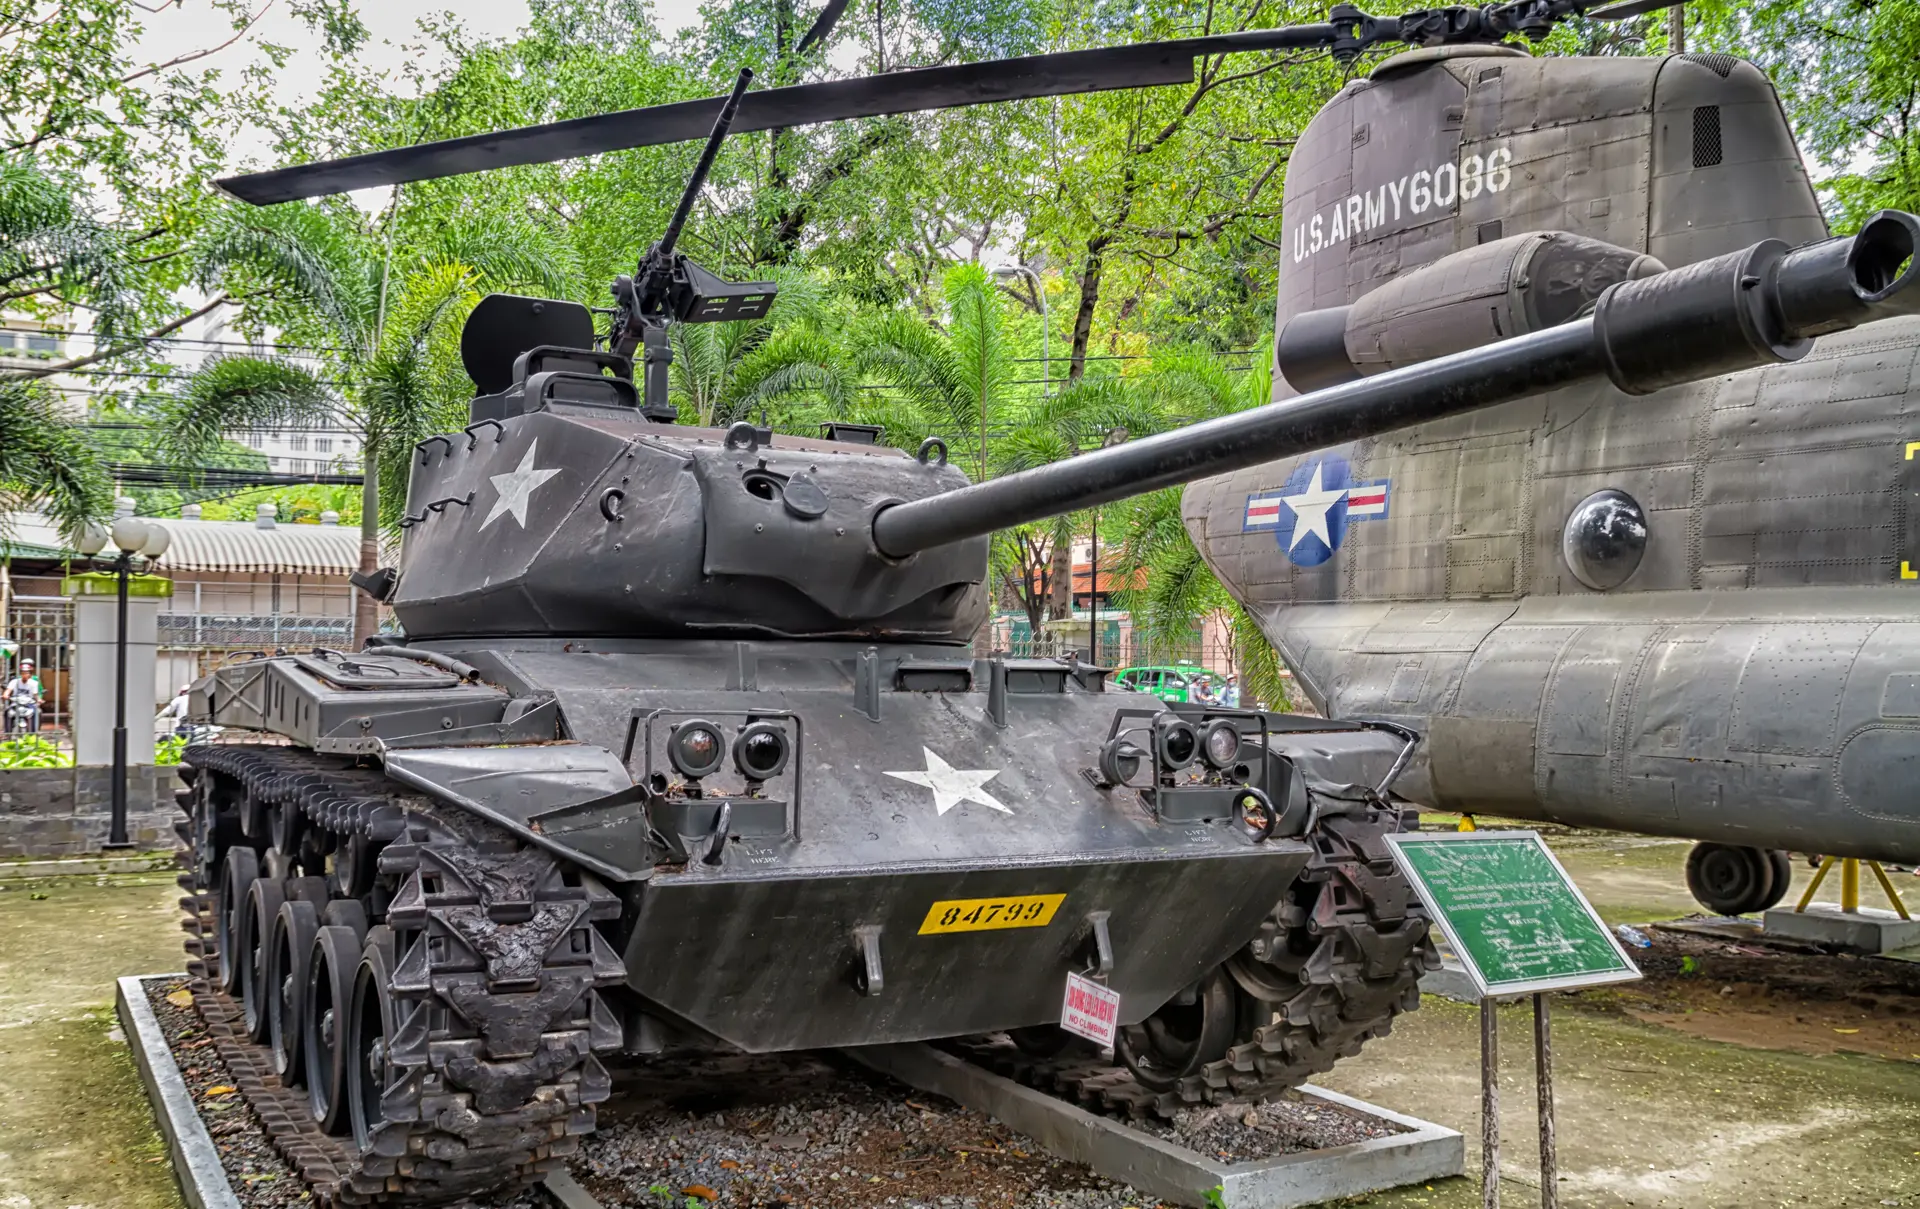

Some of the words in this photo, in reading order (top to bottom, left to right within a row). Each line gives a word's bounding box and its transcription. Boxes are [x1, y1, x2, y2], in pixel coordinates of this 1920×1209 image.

[940, 902, 1045, 926] 84799
[1068, 1013, 1079, 1025] NO
[1079, 1018, 1109, 1037] CLIMBING
